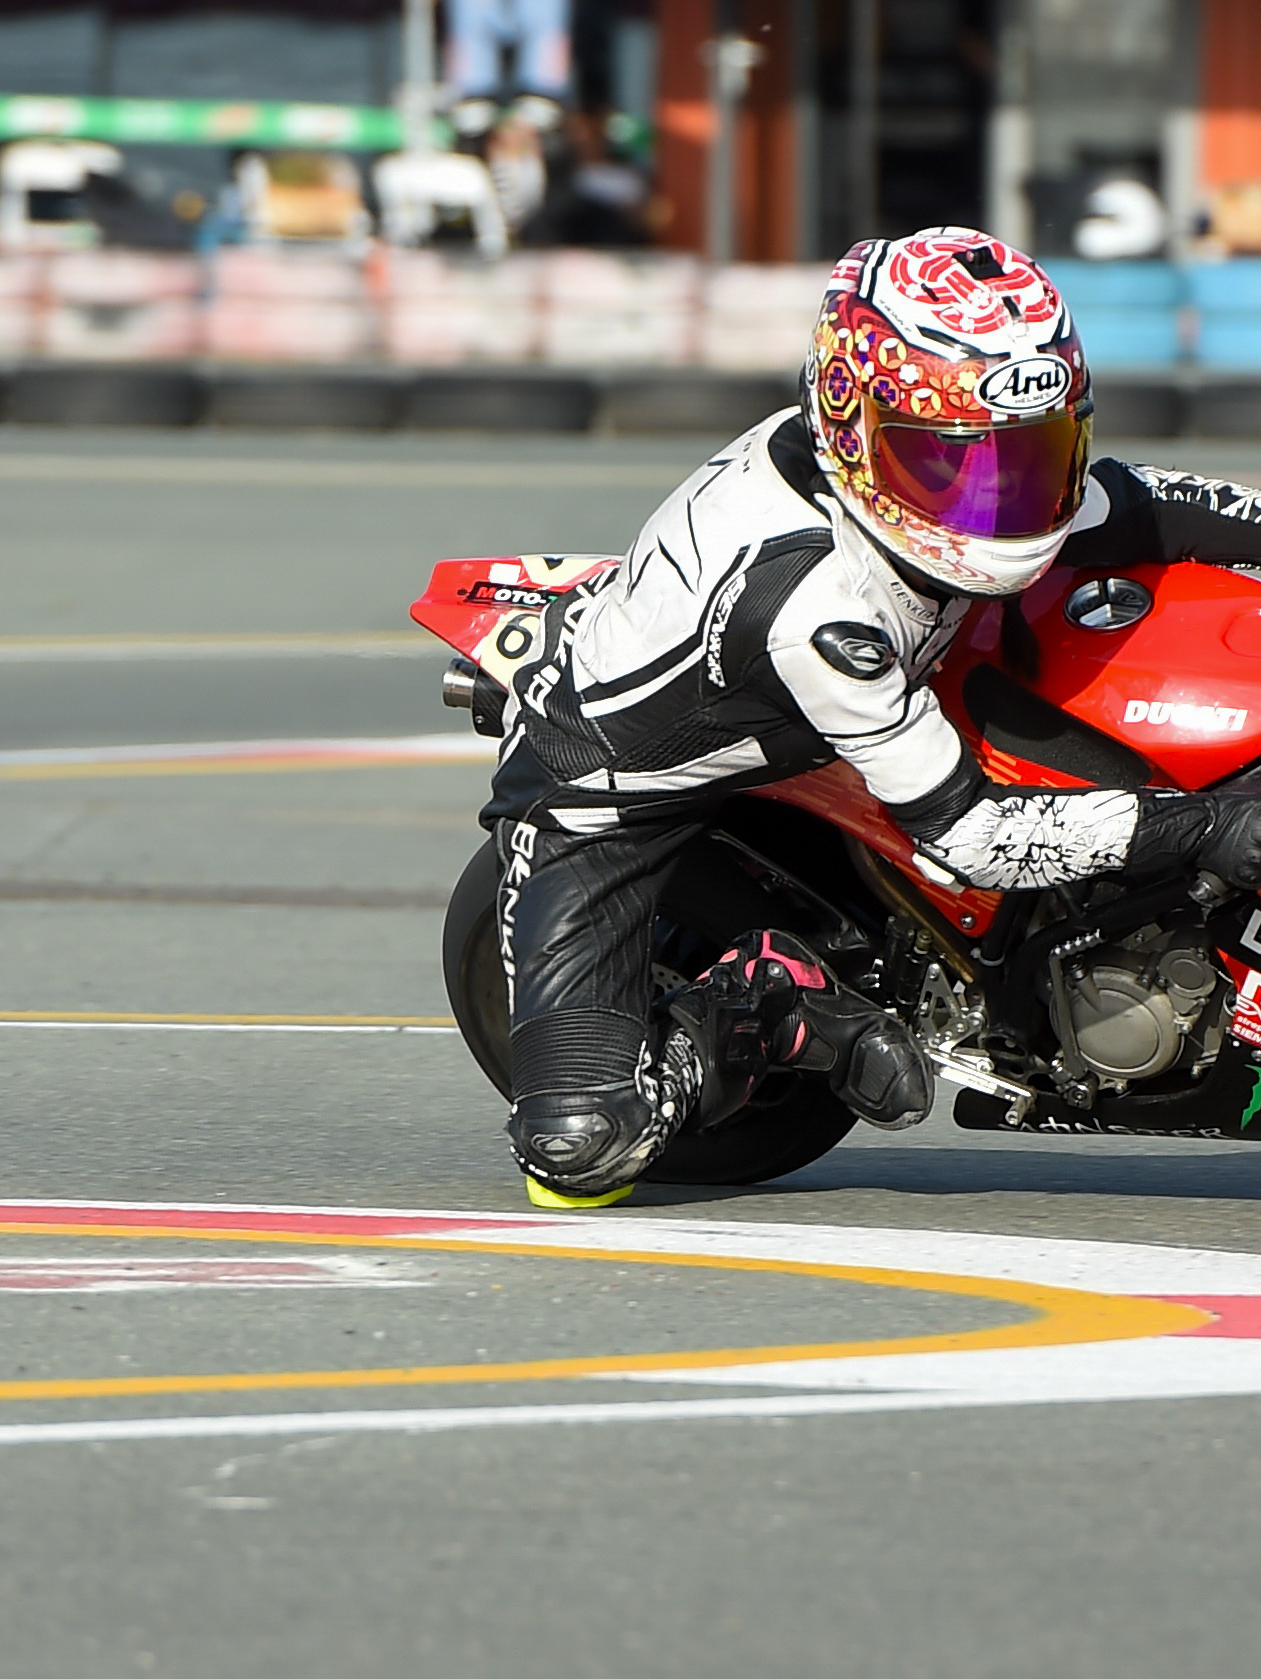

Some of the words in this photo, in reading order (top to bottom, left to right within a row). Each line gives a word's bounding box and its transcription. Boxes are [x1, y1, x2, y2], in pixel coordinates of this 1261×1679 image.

[987, 361, 1062, 401] Arai
[476, 587, 559, 605] MOTO-
[1123, 699, 1249, 732] DUCATI
